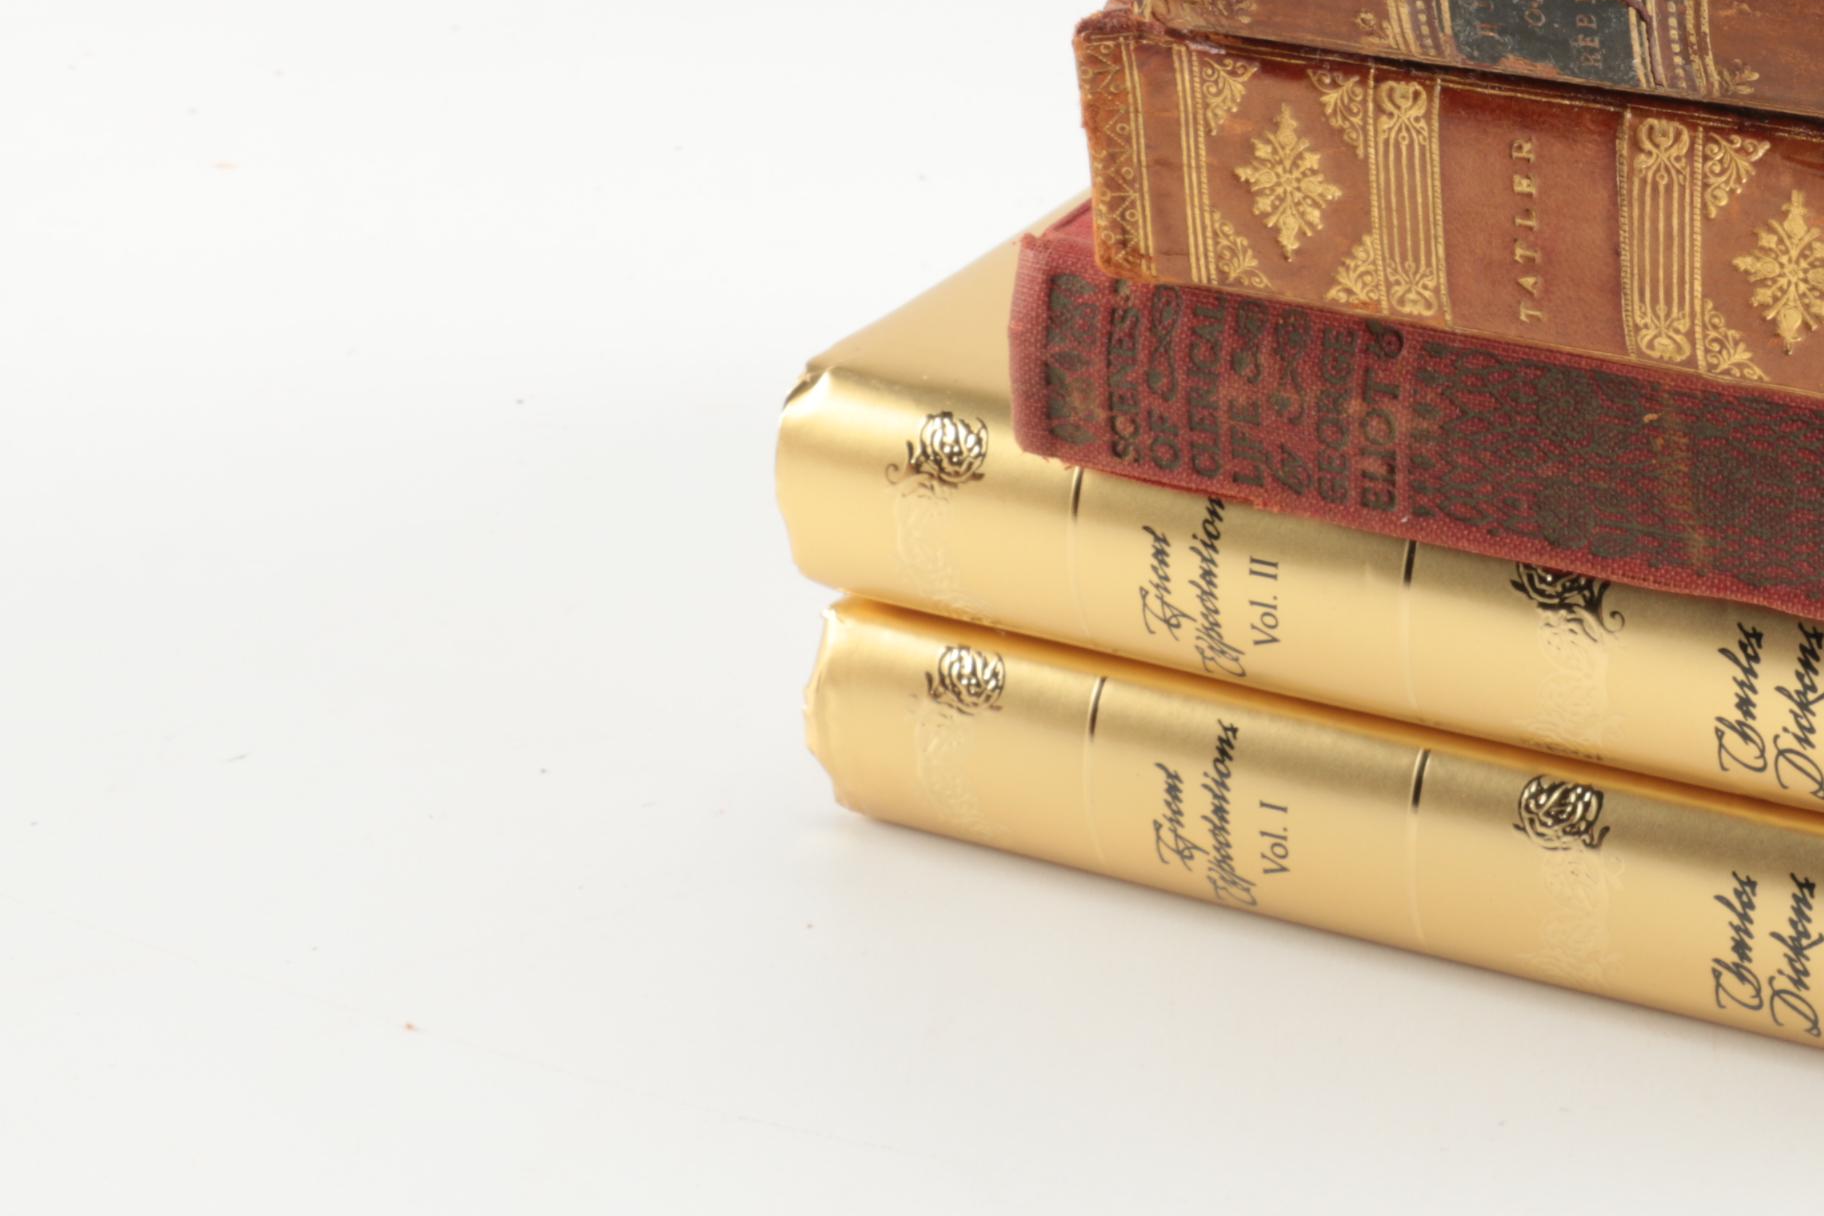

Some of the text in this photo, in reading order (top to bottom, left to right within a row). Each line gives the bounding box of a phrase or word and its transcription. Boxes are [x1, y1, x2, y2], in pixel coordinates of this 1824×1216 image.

[1511, 137, 1546, 324] TATLER
[1106, 304, 1141, 464] SCENES
[1149, 406, 1182, 471] OF
[1188, 293, 1228, 478] CLERICAL
[1230, 397, 1265, 489] LIFE
[1317, 326, 1358, 504] GEORGE
[1359, 367, 1400, 512] ELIOT
[1139, 525, 1197, 641] Great
[1189, 496, 1247, 678] Expectation
[1249, 556, 1281, 647] Vol. II
[1714, 621, 1768, 774] Charles
[1152, 761, 1209, 872] Great
[1200, 718, 1258, 907] Expectations
[1258, 799, 1292, 878] Vol. I
[1711, 870, 1765, 1011] Charles
